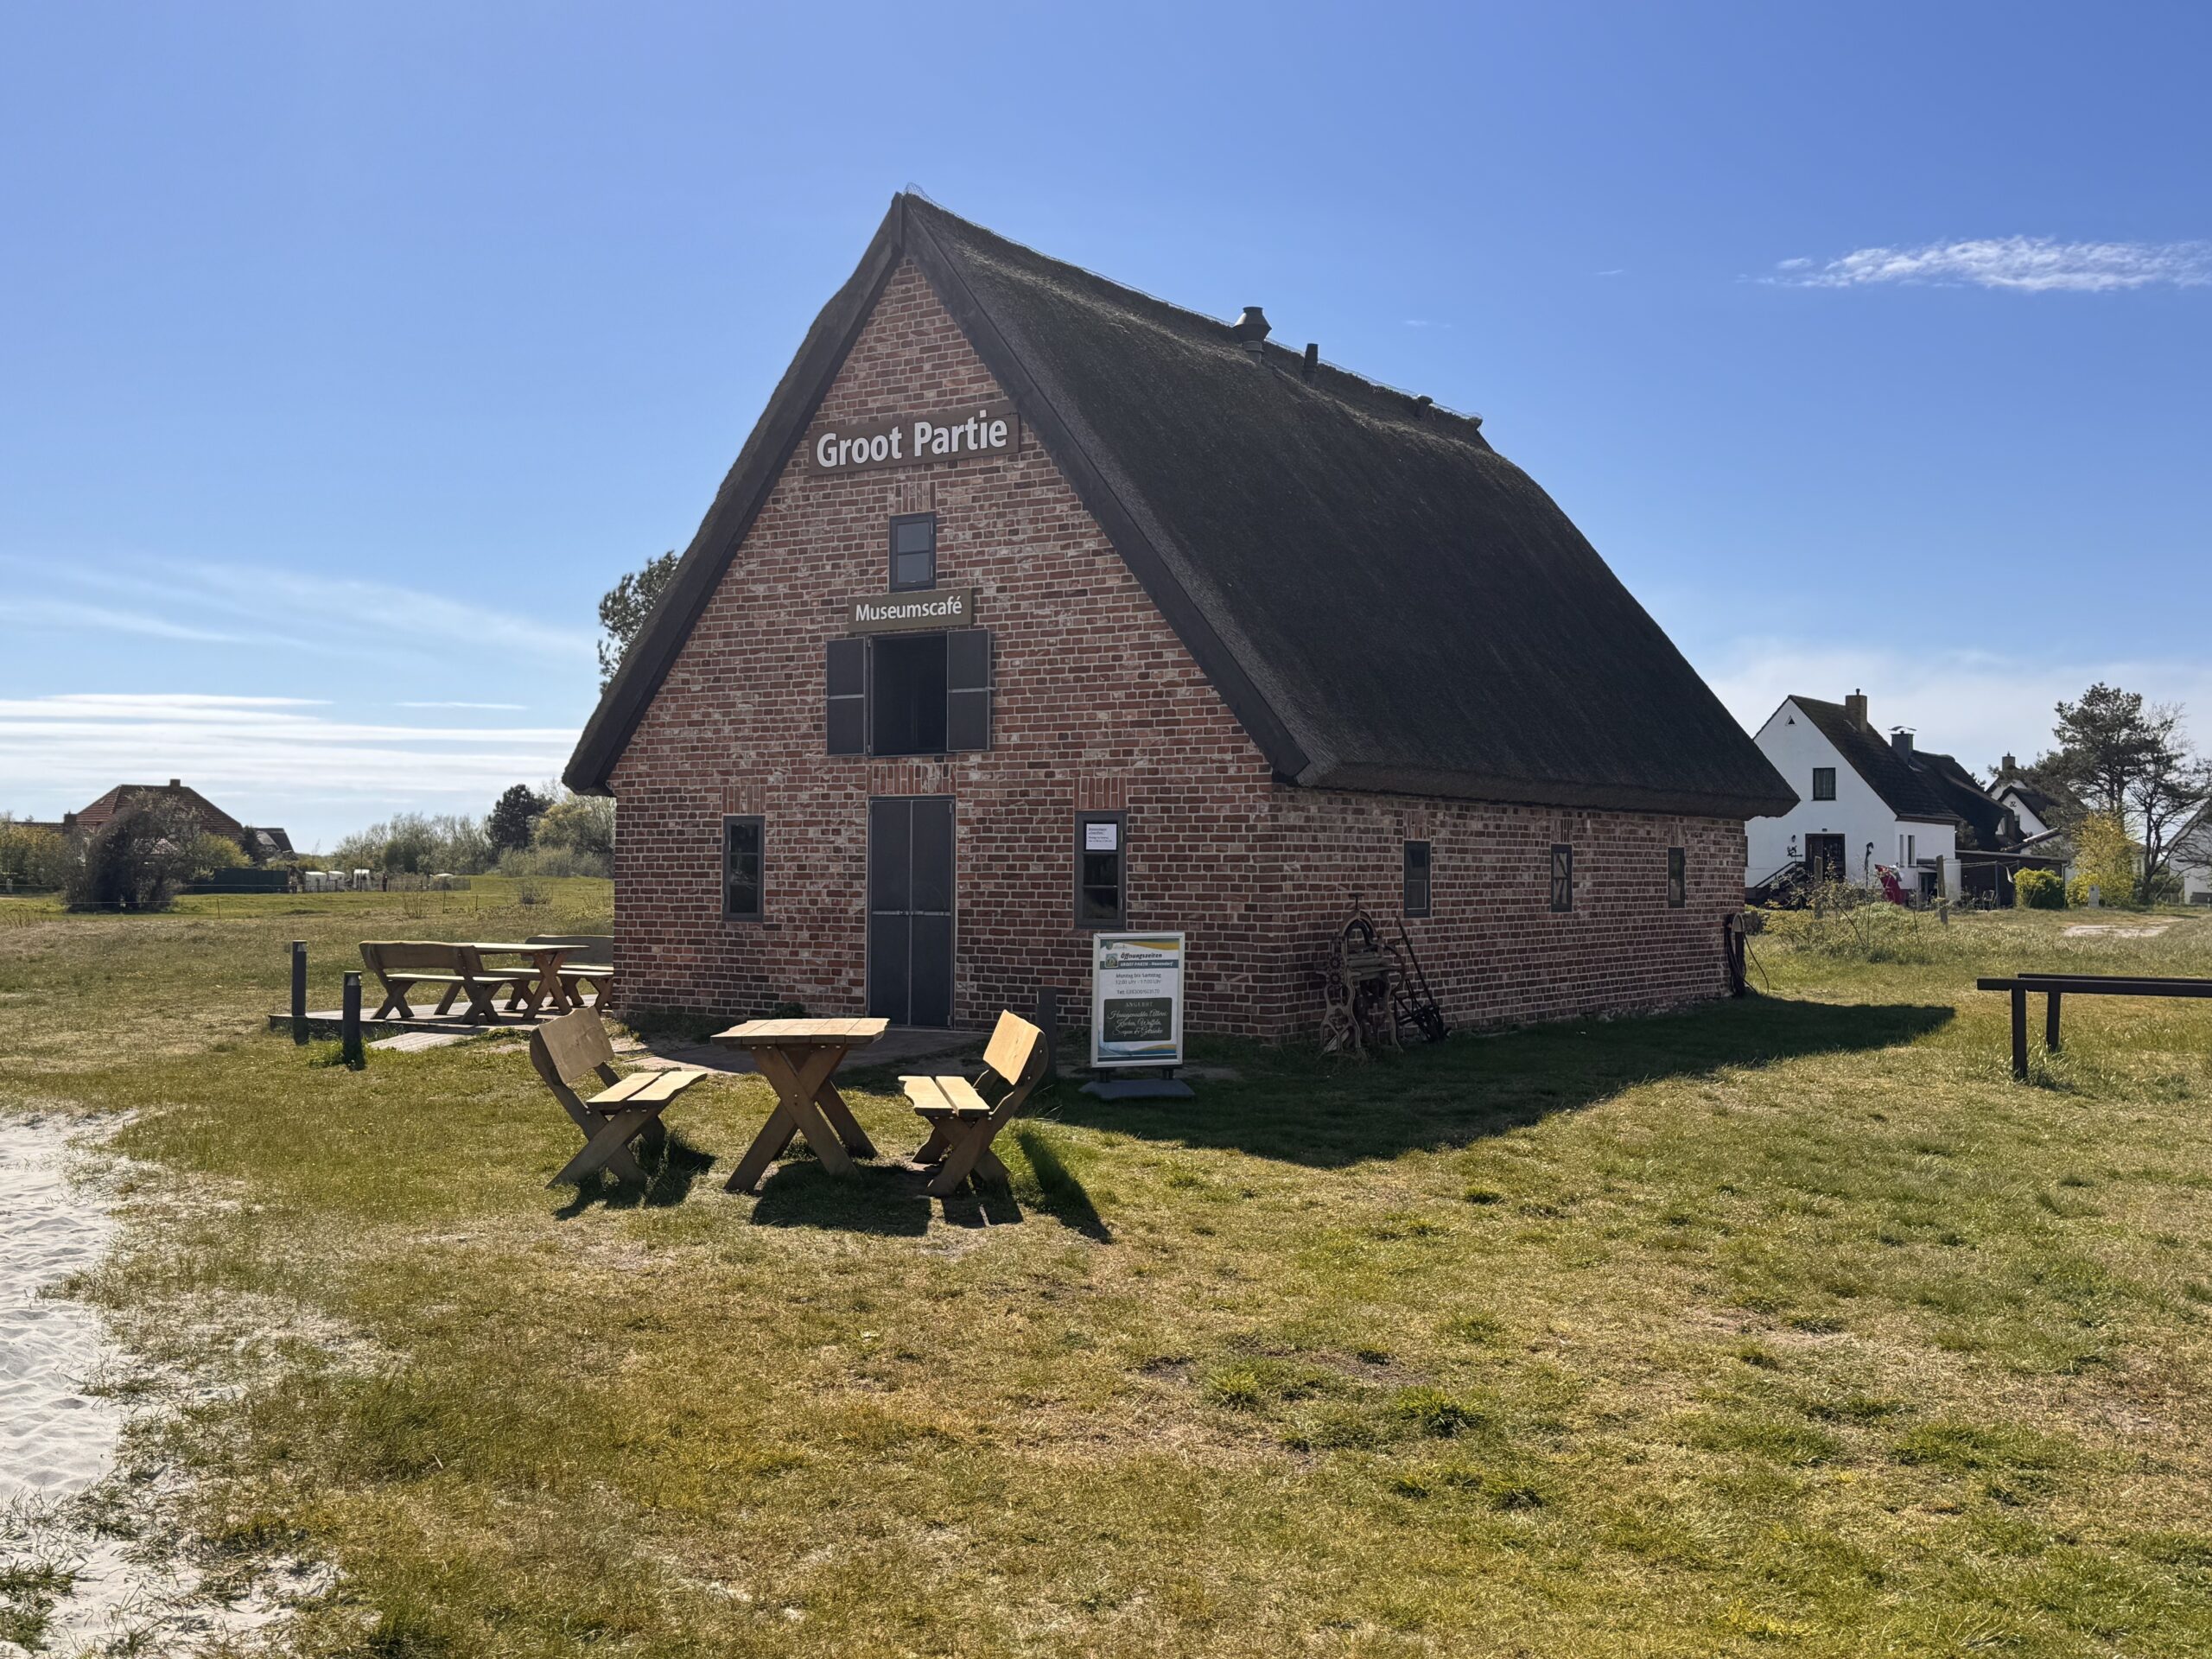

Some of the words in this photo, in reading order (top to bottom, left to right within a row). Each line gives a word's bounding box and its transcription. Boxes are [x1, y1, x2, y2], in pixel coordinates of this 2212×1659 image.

[817, 426, 902, 467] Groot
[914, 410, 1007, 457] Partie
[855, 595, 962, 621] Museumscafé
